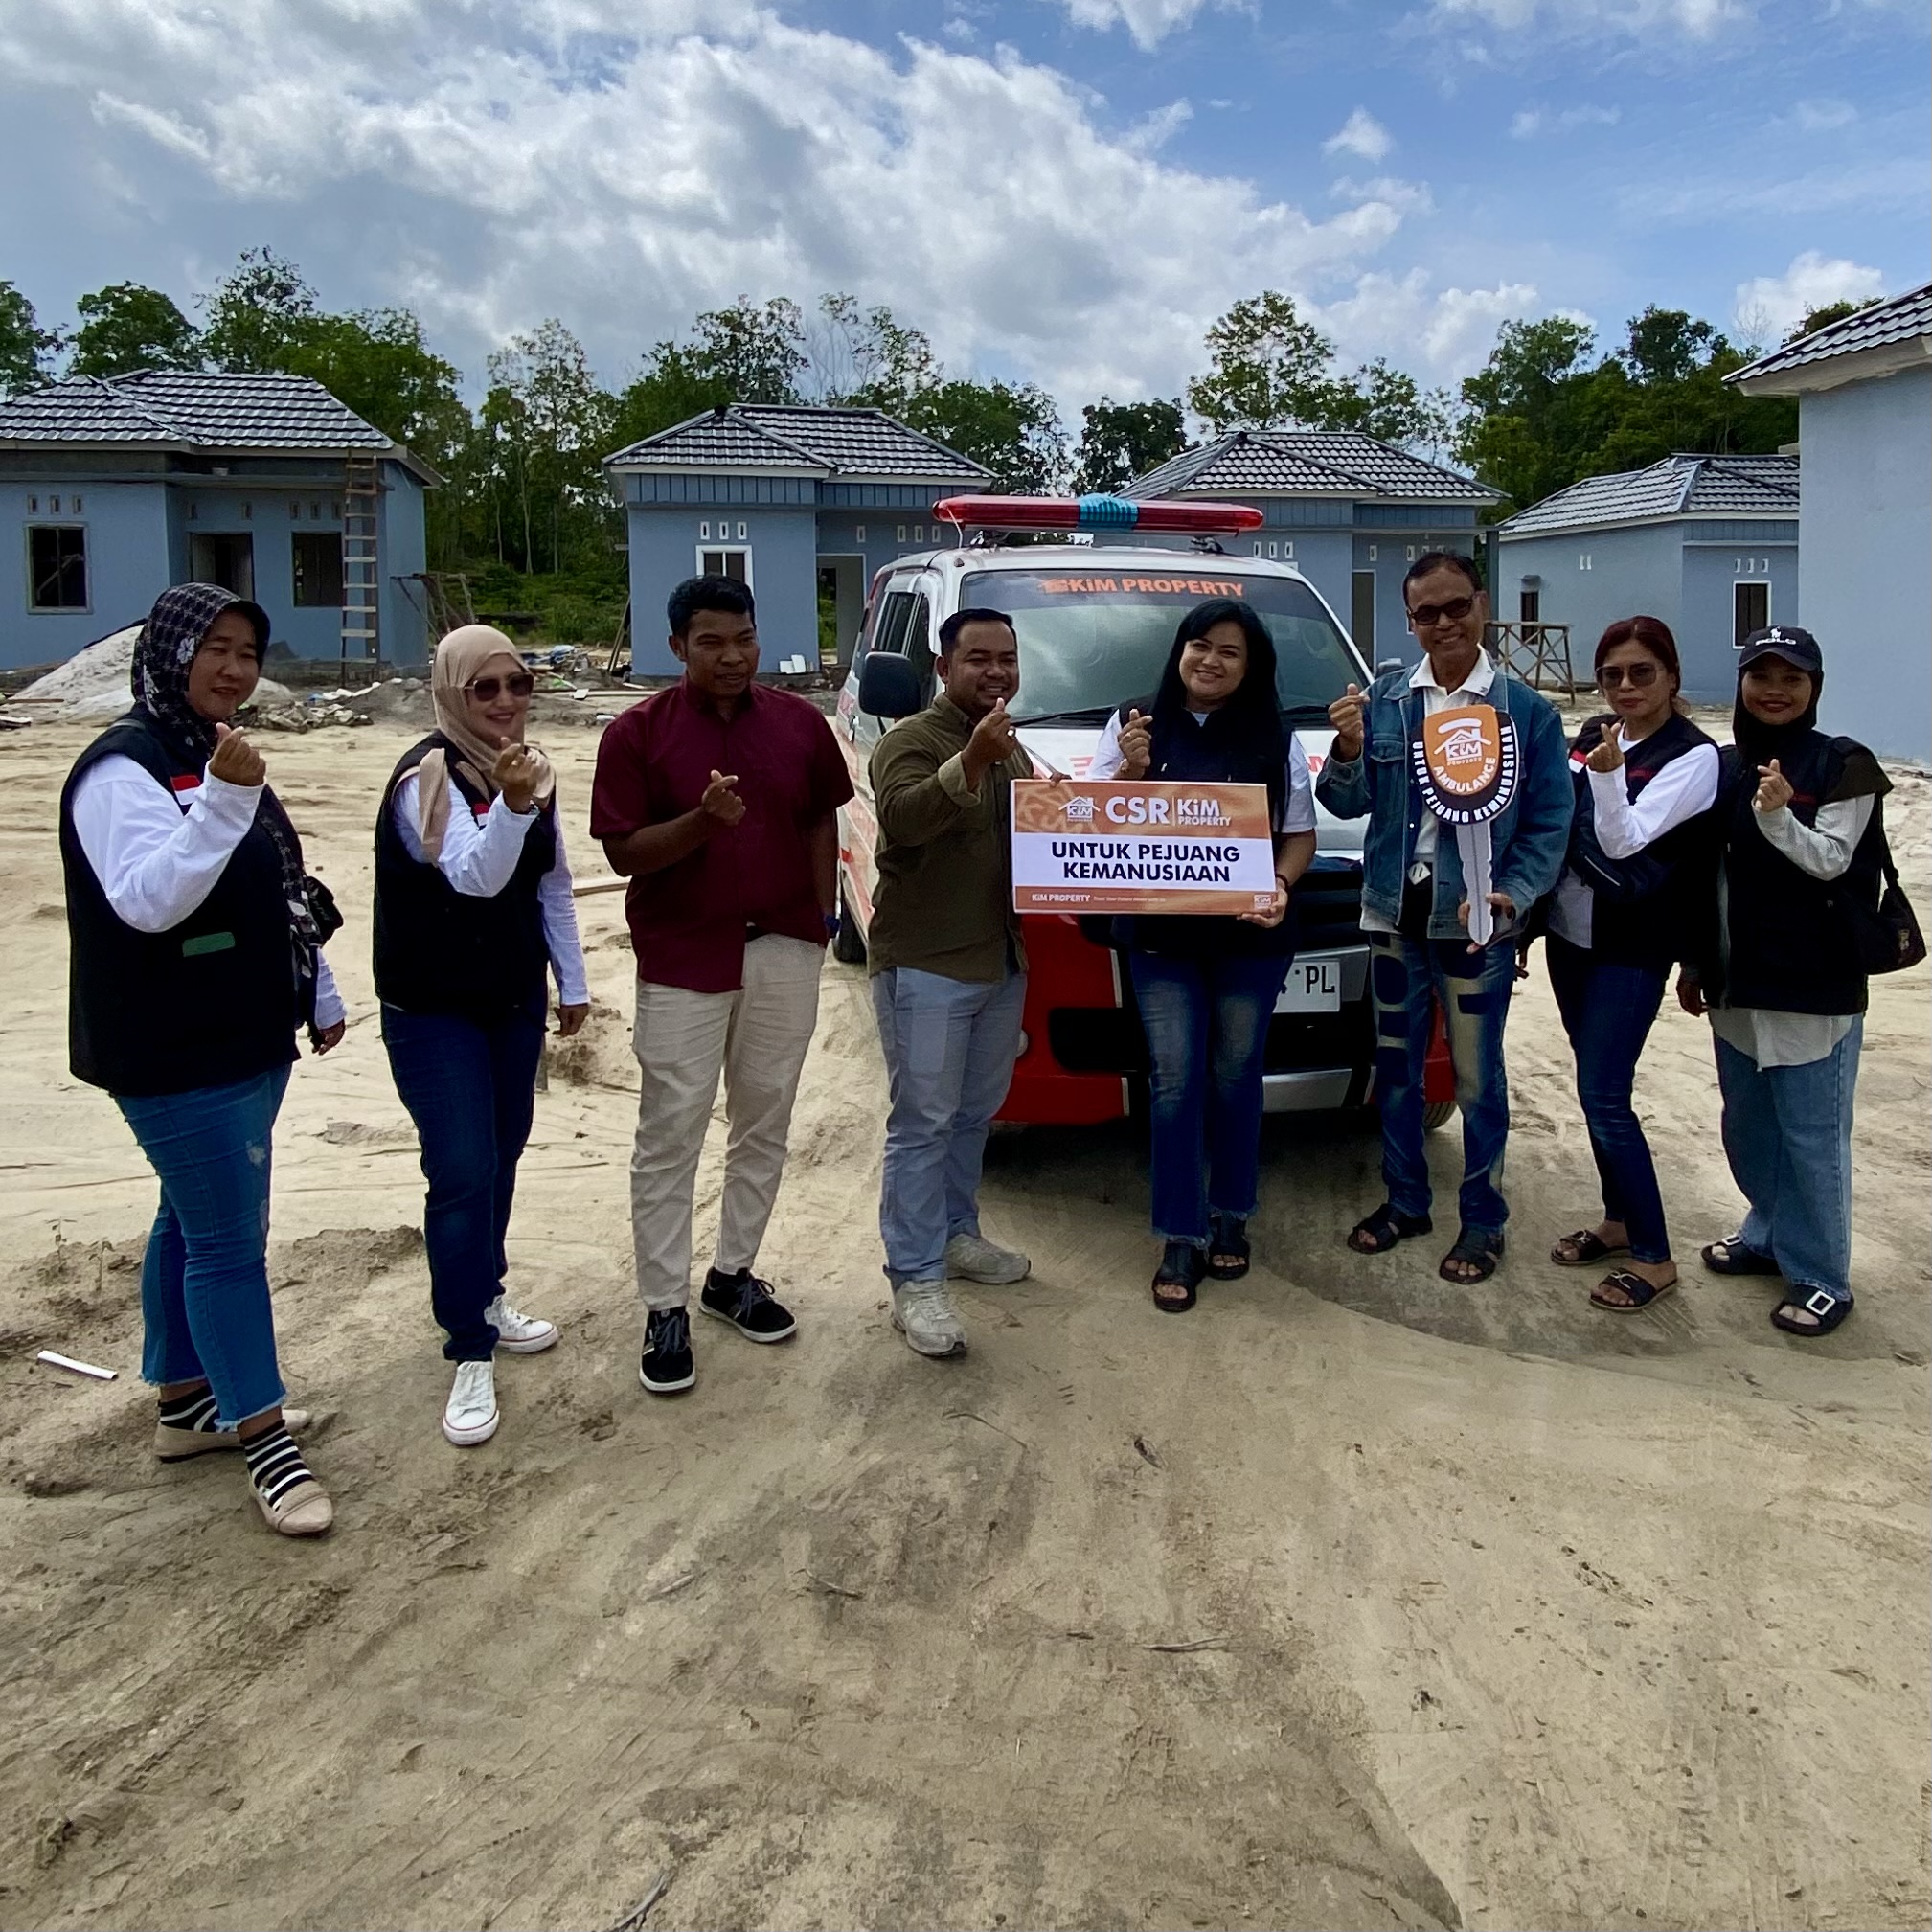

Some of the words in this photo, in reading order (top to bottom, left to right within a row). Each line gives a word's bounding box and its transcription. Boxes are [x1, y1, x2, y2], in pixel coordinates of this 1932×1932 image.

[1068, 578, 1118, 593] KiM
[1121, 579, 1243, 597] PROPERTY
[1412, 741, 1431, 785] UNTUK
[1433, 757, 1496, 793] AMBULANCE
[1473, 725, 1515, 822] KEMANUSIAAN
[1105, 796, 1171, 825] CSR
[1177, 798, 1221, 817] KiM
[1421, 786, 1469, 824] PEJUANG
[1177, 816, 1232, 827] PROPERTY
[1052, 841, 1131, 860] UNTUK
[1138, 843, 1240, 863] PEJUANG
[1063, 861, 1230, 882] KEMANUSIAAN
[1049, 894, 1091, 902] PROPERTY
[1305, 966, 1335, 994] PL
